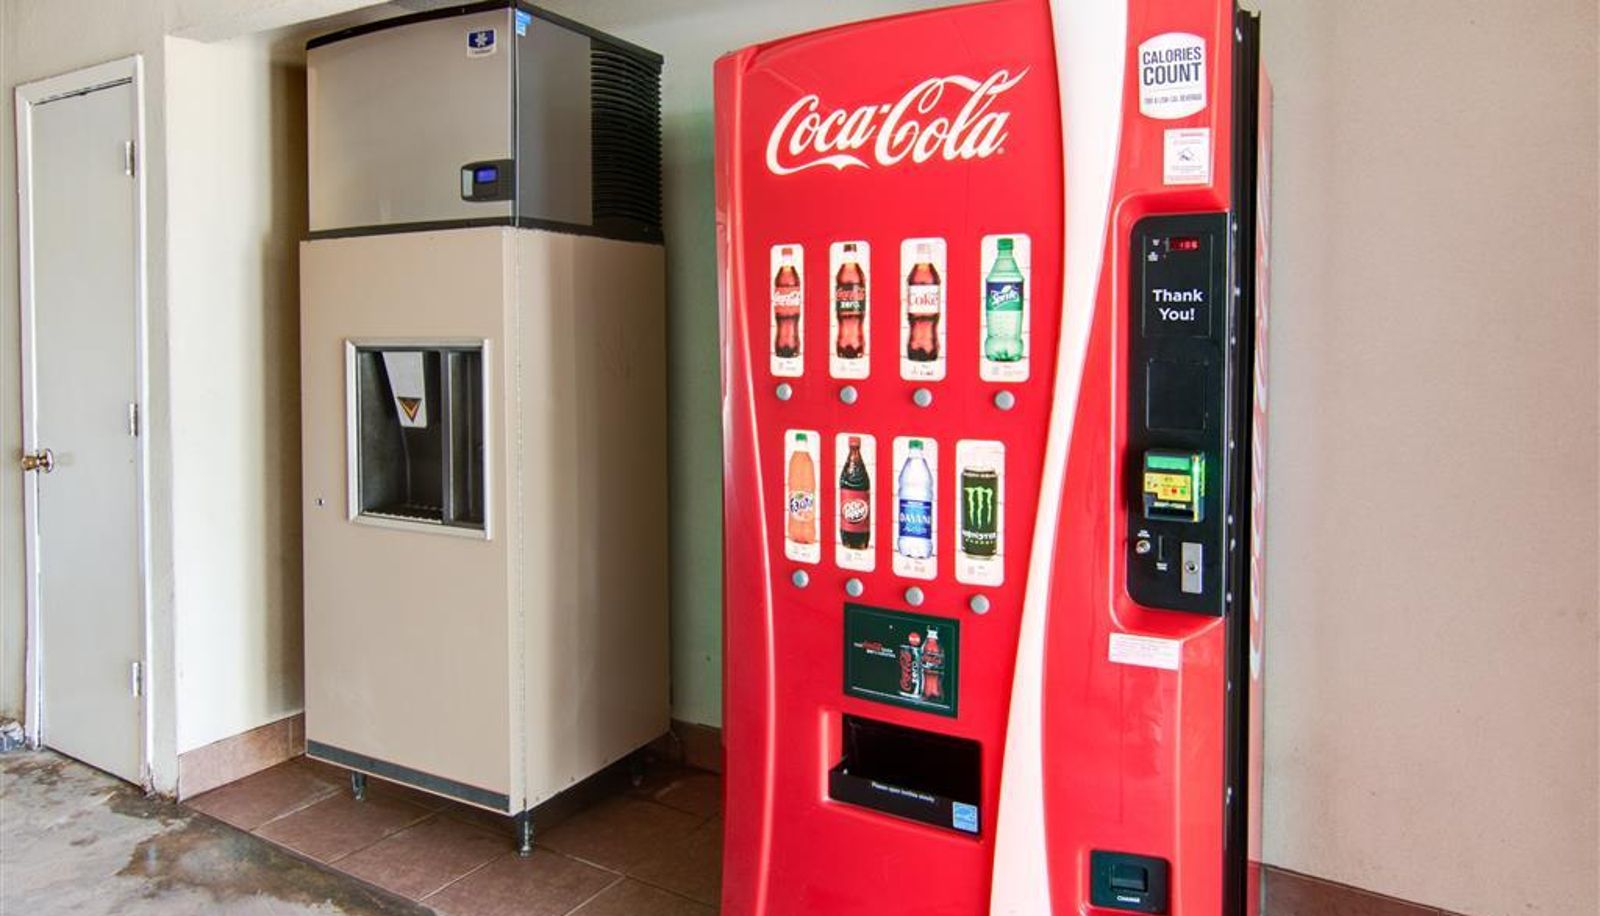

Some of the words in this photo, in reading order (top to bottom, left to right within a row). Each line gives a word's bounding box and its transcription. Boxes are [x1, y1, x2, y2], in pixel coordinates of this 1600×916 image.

[1143, 47, 1202, 66] CALORIES
[1143, 62, 1202, 86] COUNT
[766, 65, 1030, 175] Coca-Cola
[1152, 288, 1203, 302] Thank
[1159, 307, 1195, 320] You!
